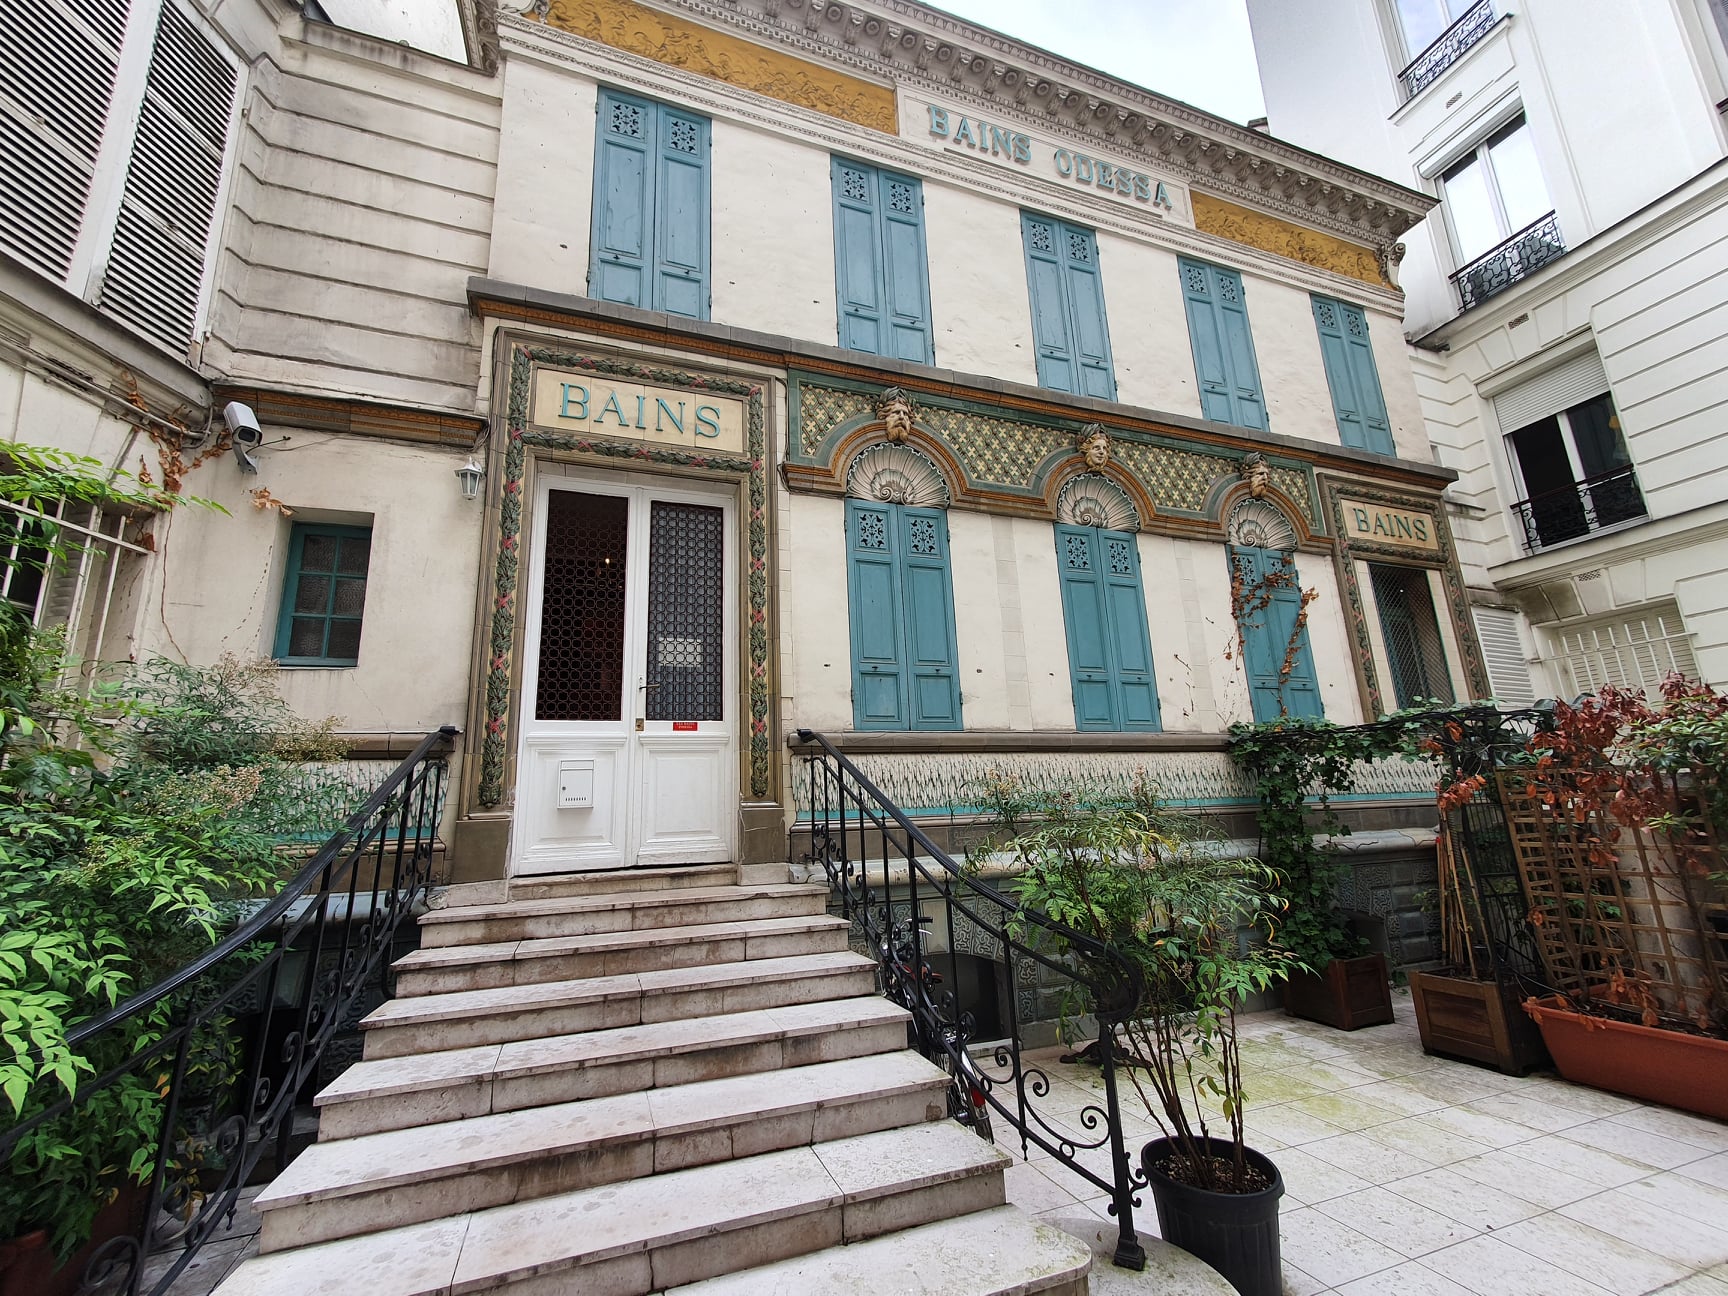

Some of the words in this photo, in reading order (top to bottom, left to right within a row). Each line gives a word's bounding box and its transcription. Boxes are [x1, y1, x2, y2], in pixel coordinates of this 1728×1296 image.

[928, 105, 1031, 161] BAINS
[1053, 149, 1172, 210] ODESSA
[558, 382, 721, 438] BAINS
[1353, 508, 1428, 541] BAINS
